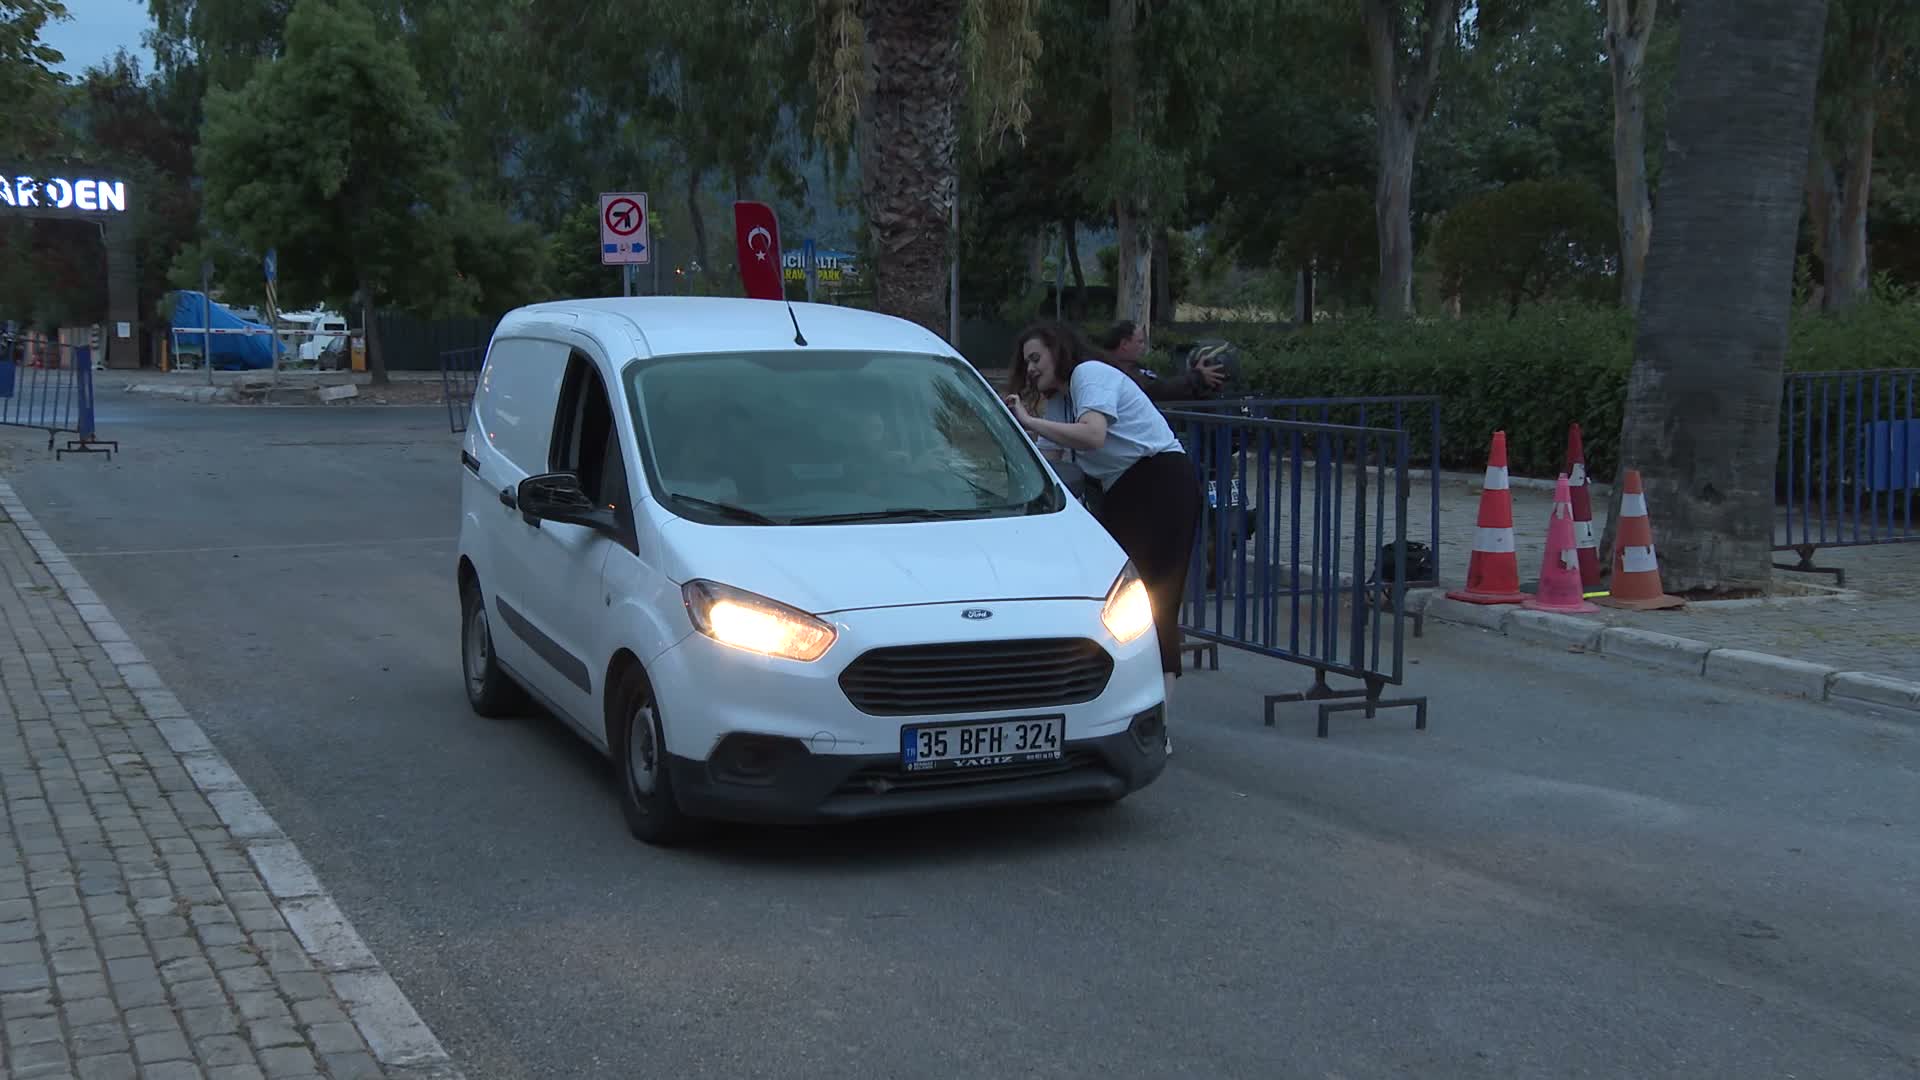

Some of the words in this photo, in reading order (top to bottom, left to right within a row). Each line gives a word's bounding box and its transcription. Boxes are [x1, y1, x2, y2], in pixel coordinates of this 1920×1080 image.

[919, 730, 948, 758] 35
[960, 726, 1003, 755] BFH
[1015, 723, 1057, 750] 324
